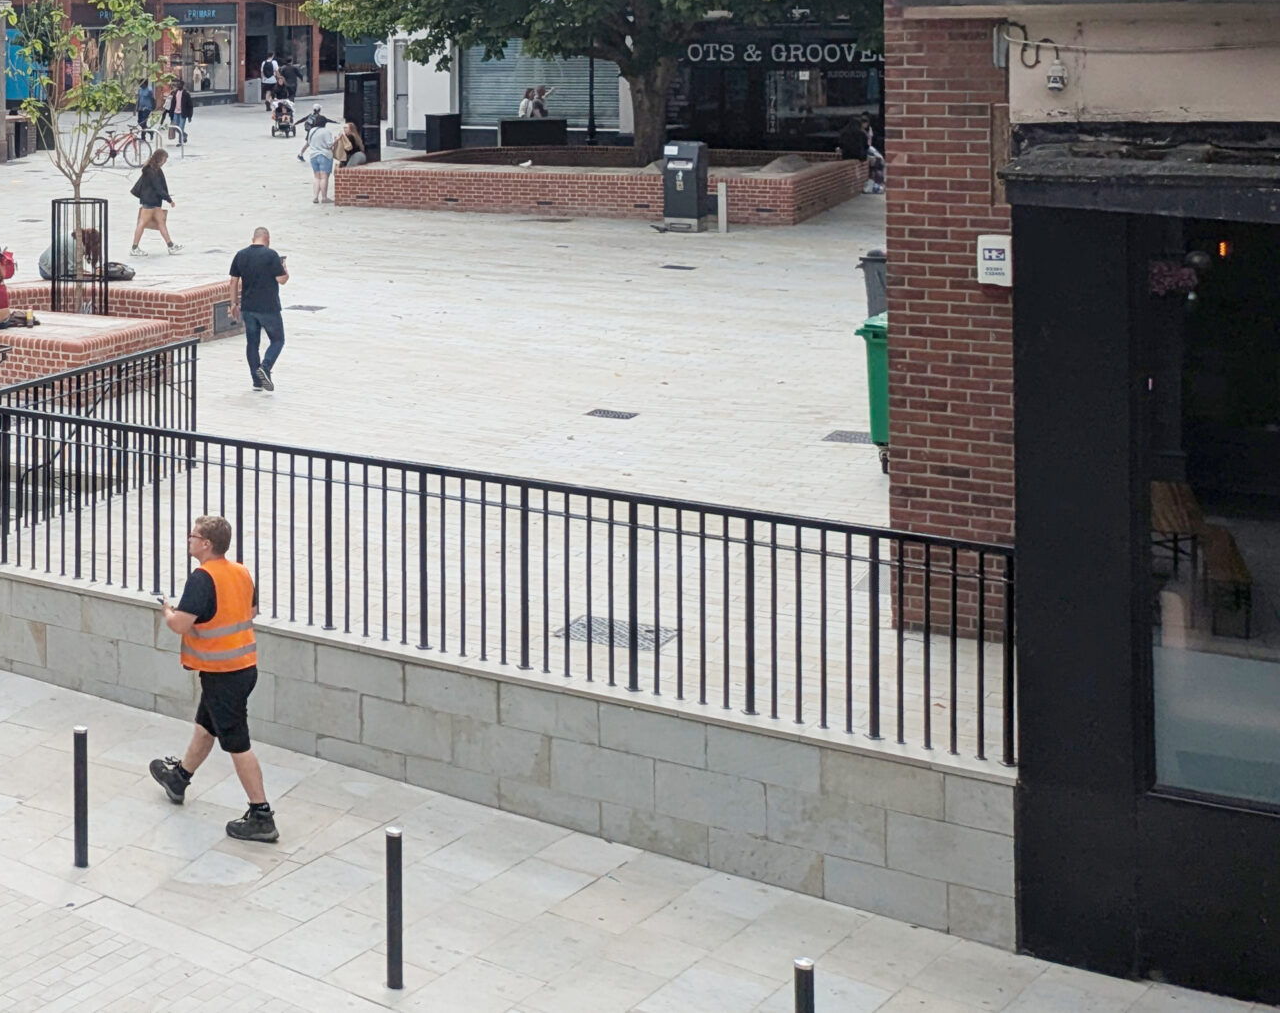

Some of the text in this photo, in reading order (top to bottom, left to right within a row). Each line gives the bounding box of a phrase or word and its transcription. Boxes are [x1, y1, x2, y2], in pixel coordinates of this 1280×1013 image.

[187, 9, 216, 18] PRIMARK
[678, 44, 735, 62] OTS
[743, 44, 762, 62] &
